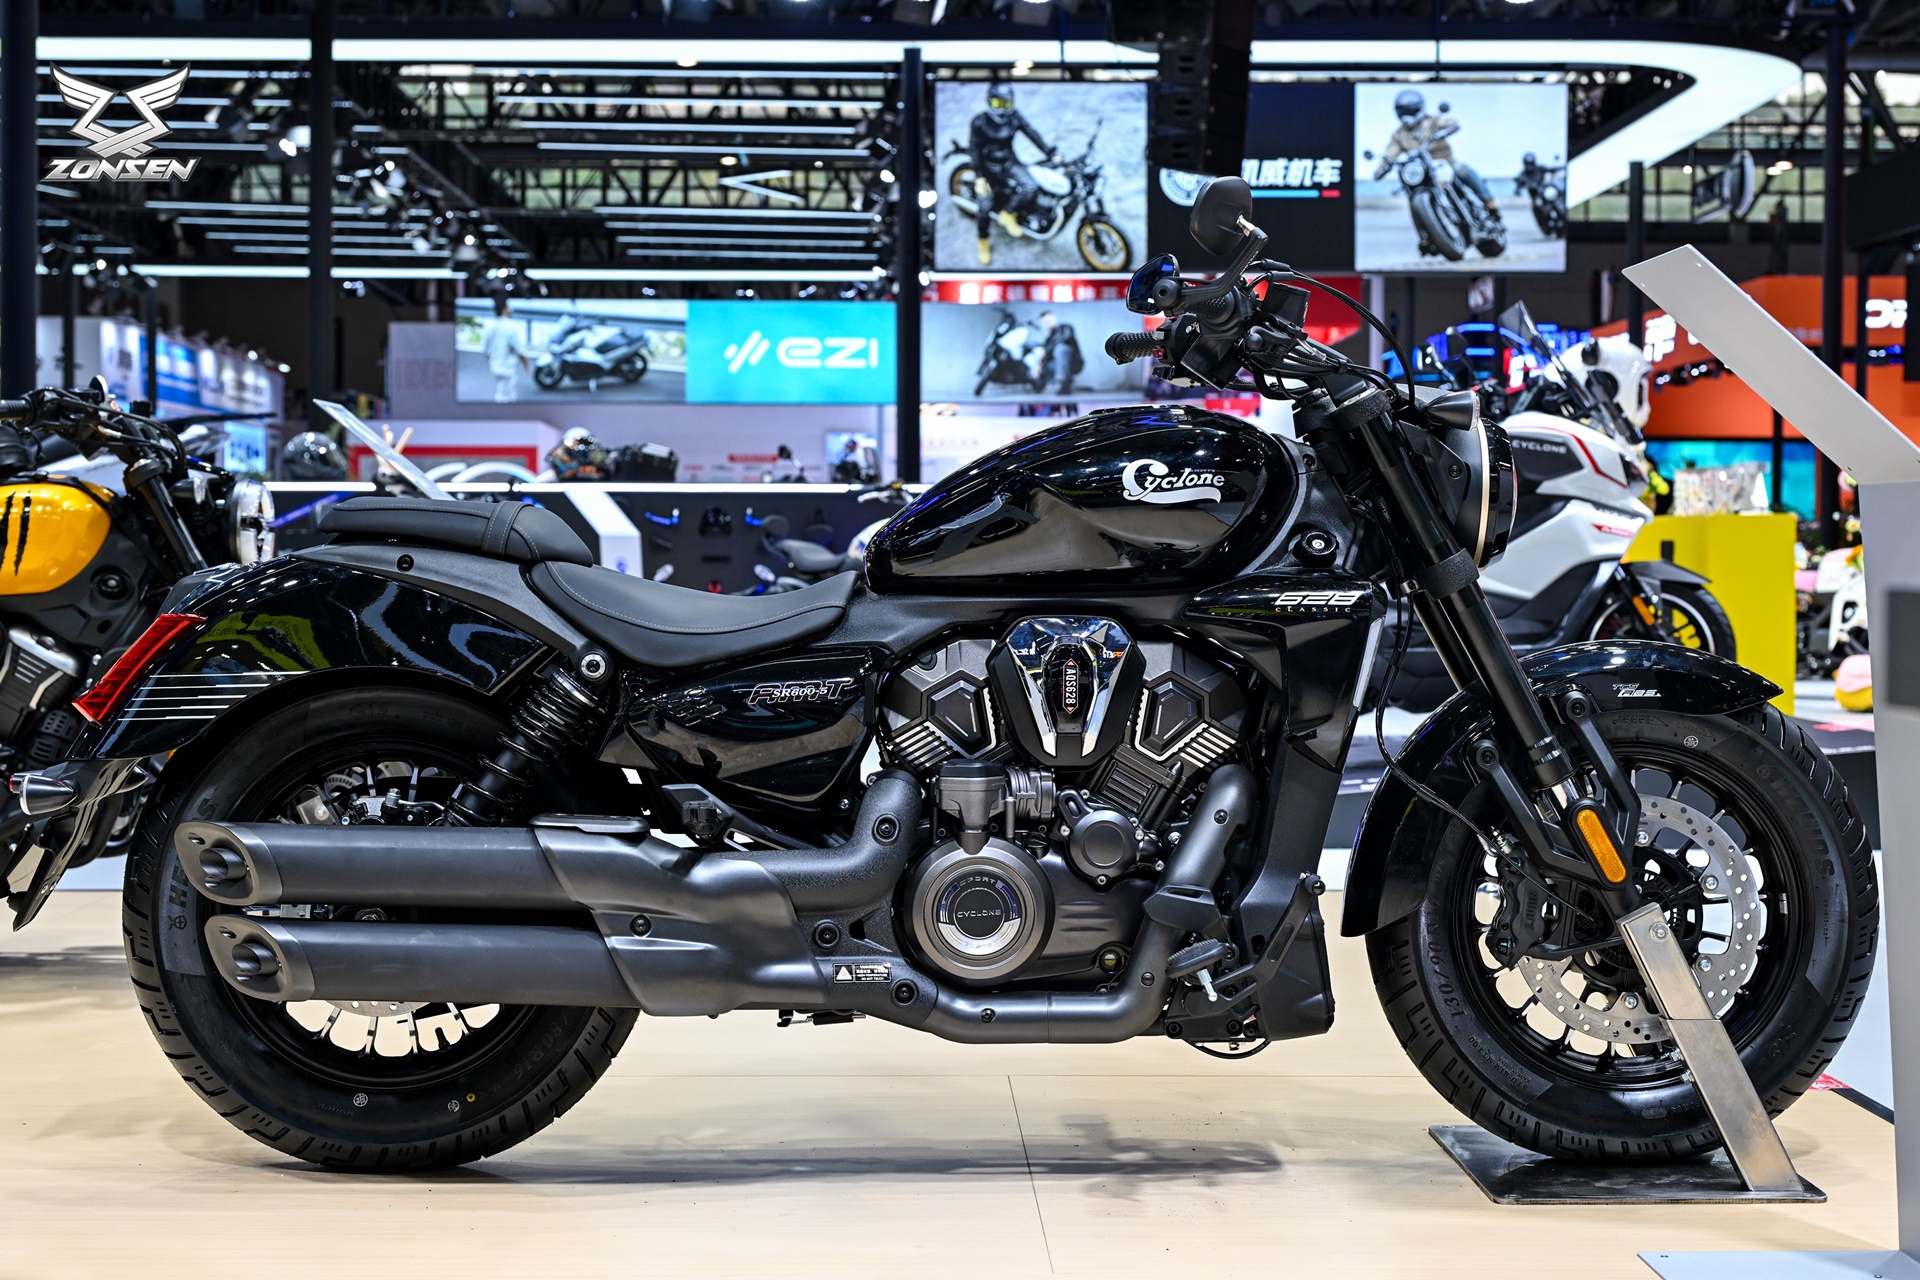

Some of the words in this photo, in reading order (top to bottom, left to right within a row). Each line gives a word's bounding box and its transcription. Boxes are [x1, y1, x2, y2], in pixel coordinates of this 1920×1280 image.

[1511, 439, 1567, 455] CYCLONE
[1122, 459, 1225, 503] Cyclone
[1274, 591, 1365, 606] 628
[1065, 668, 1077, 705] AQS628
[959, 876, 996, 887] SPORT
[957, 909, 1002, 918] CYCLONE
